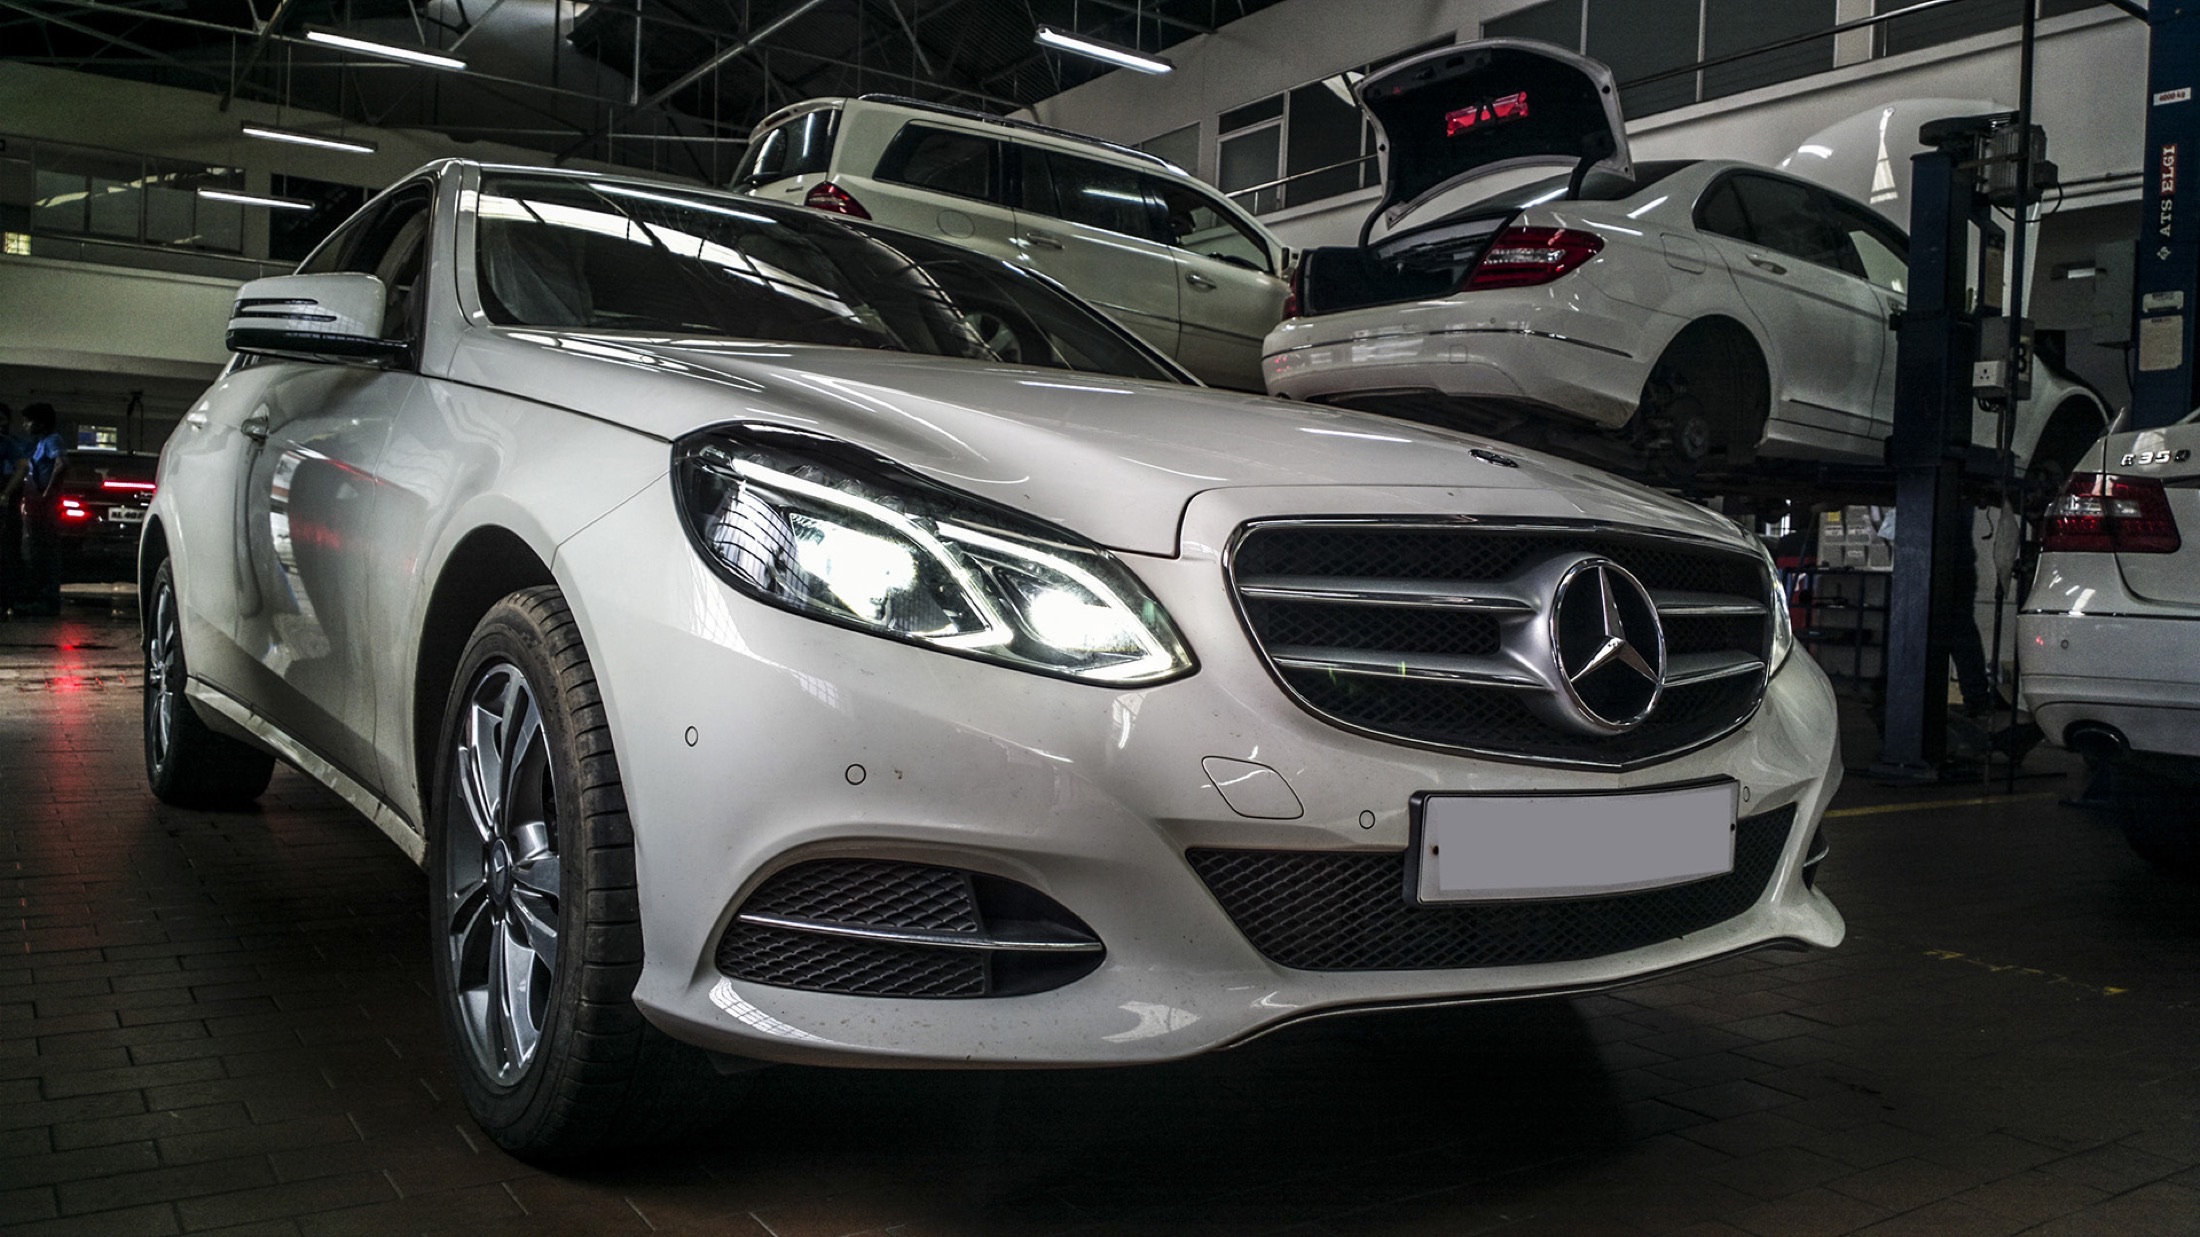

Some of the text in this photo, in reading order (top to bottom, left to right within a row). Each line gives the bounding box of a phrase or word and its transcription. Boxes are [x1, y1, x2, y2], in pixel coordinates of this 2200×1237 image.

[2159, 145, 2176, 237] ATS ELGI
[2137, 449, 2191, 465] 350
